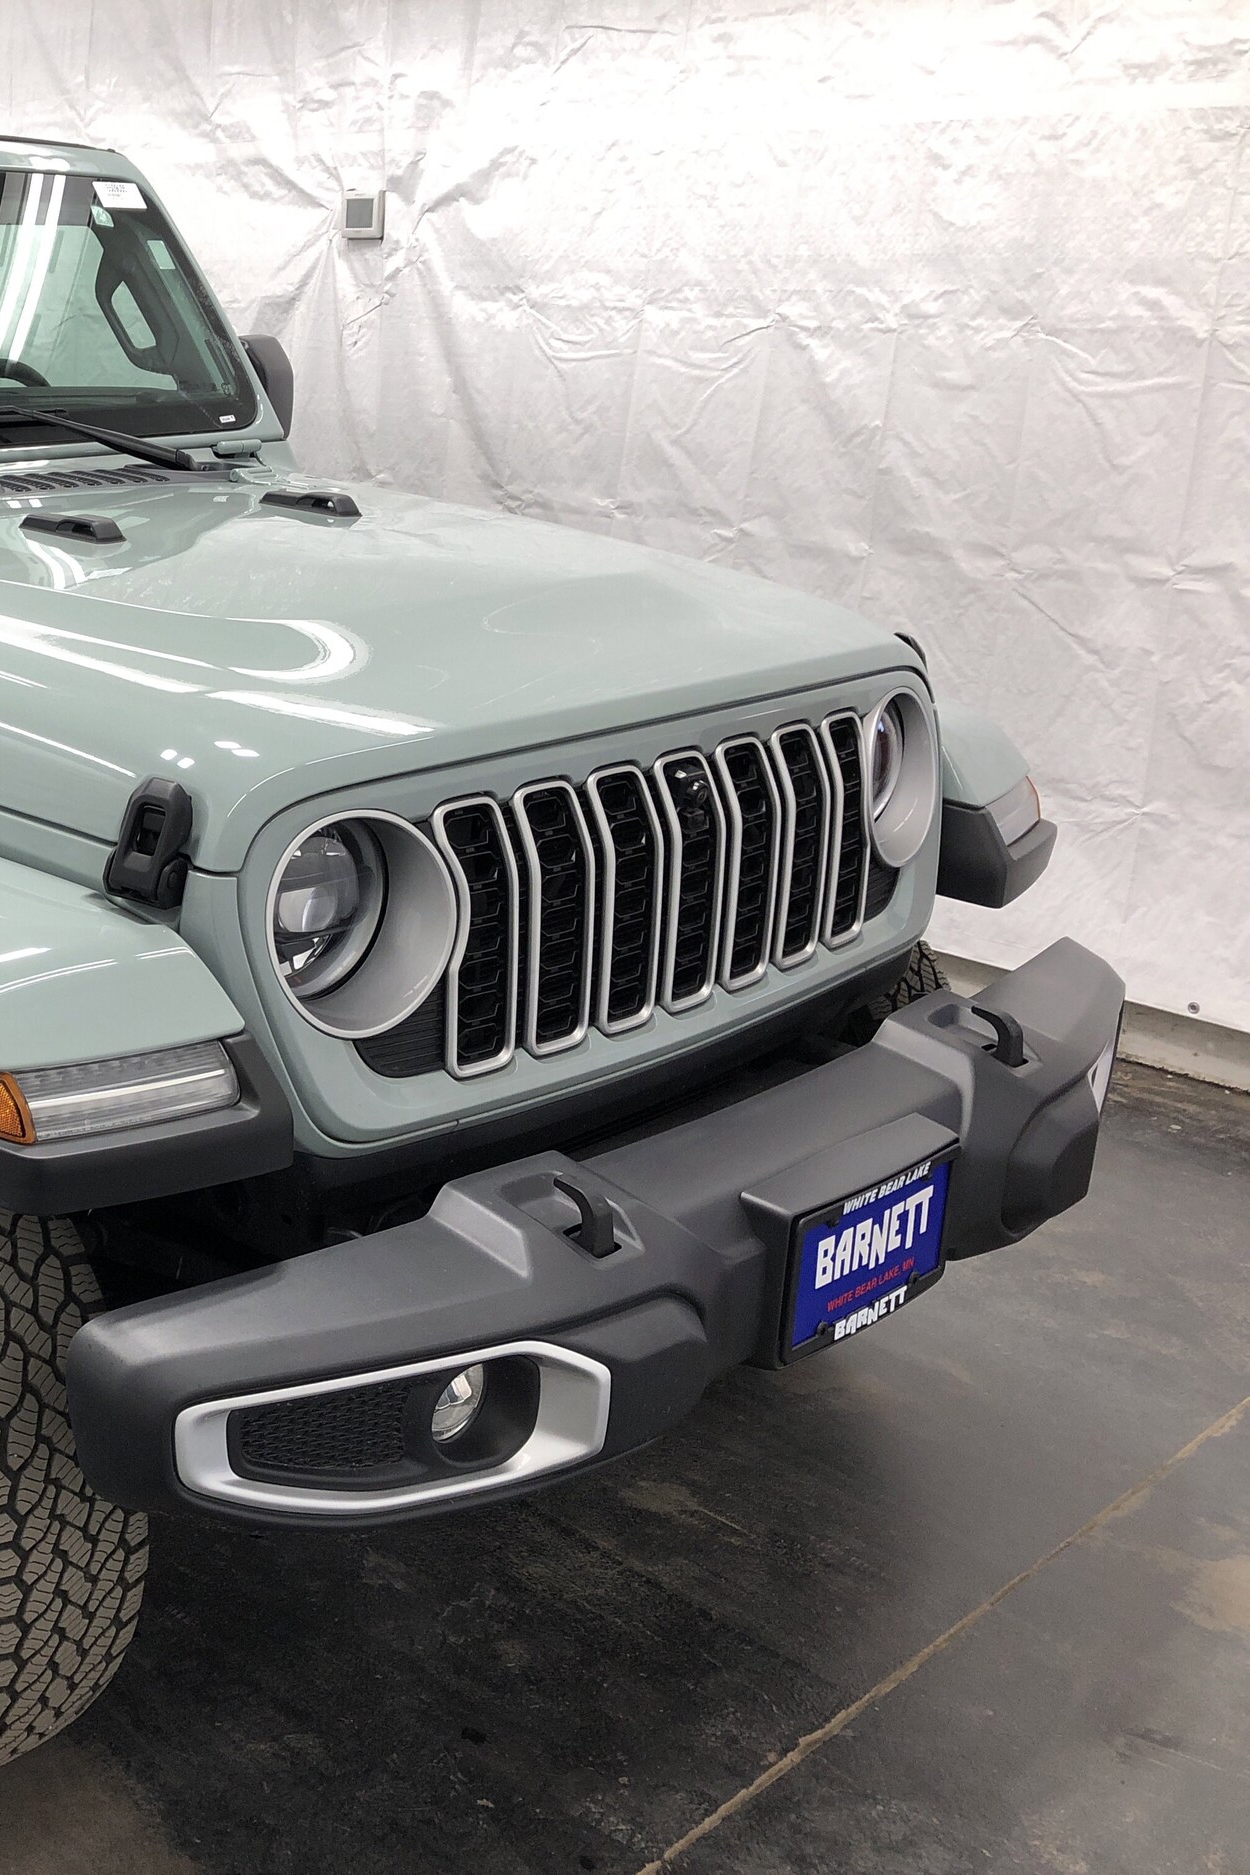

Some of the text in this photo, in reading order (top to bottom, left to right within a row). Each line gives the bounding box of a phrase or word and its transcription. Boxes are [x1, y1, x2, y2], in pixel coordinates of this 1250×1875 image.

[843, 1161, 931, 1215] WHITE BEAR LAKE
[815, 1184, 934, 1289] BARNETT
[827, 1290, 854, 1312] WHITE
[854, 1277, 877, 1298] BEAR
[834, 1285, 908, 1340] BARNETT
